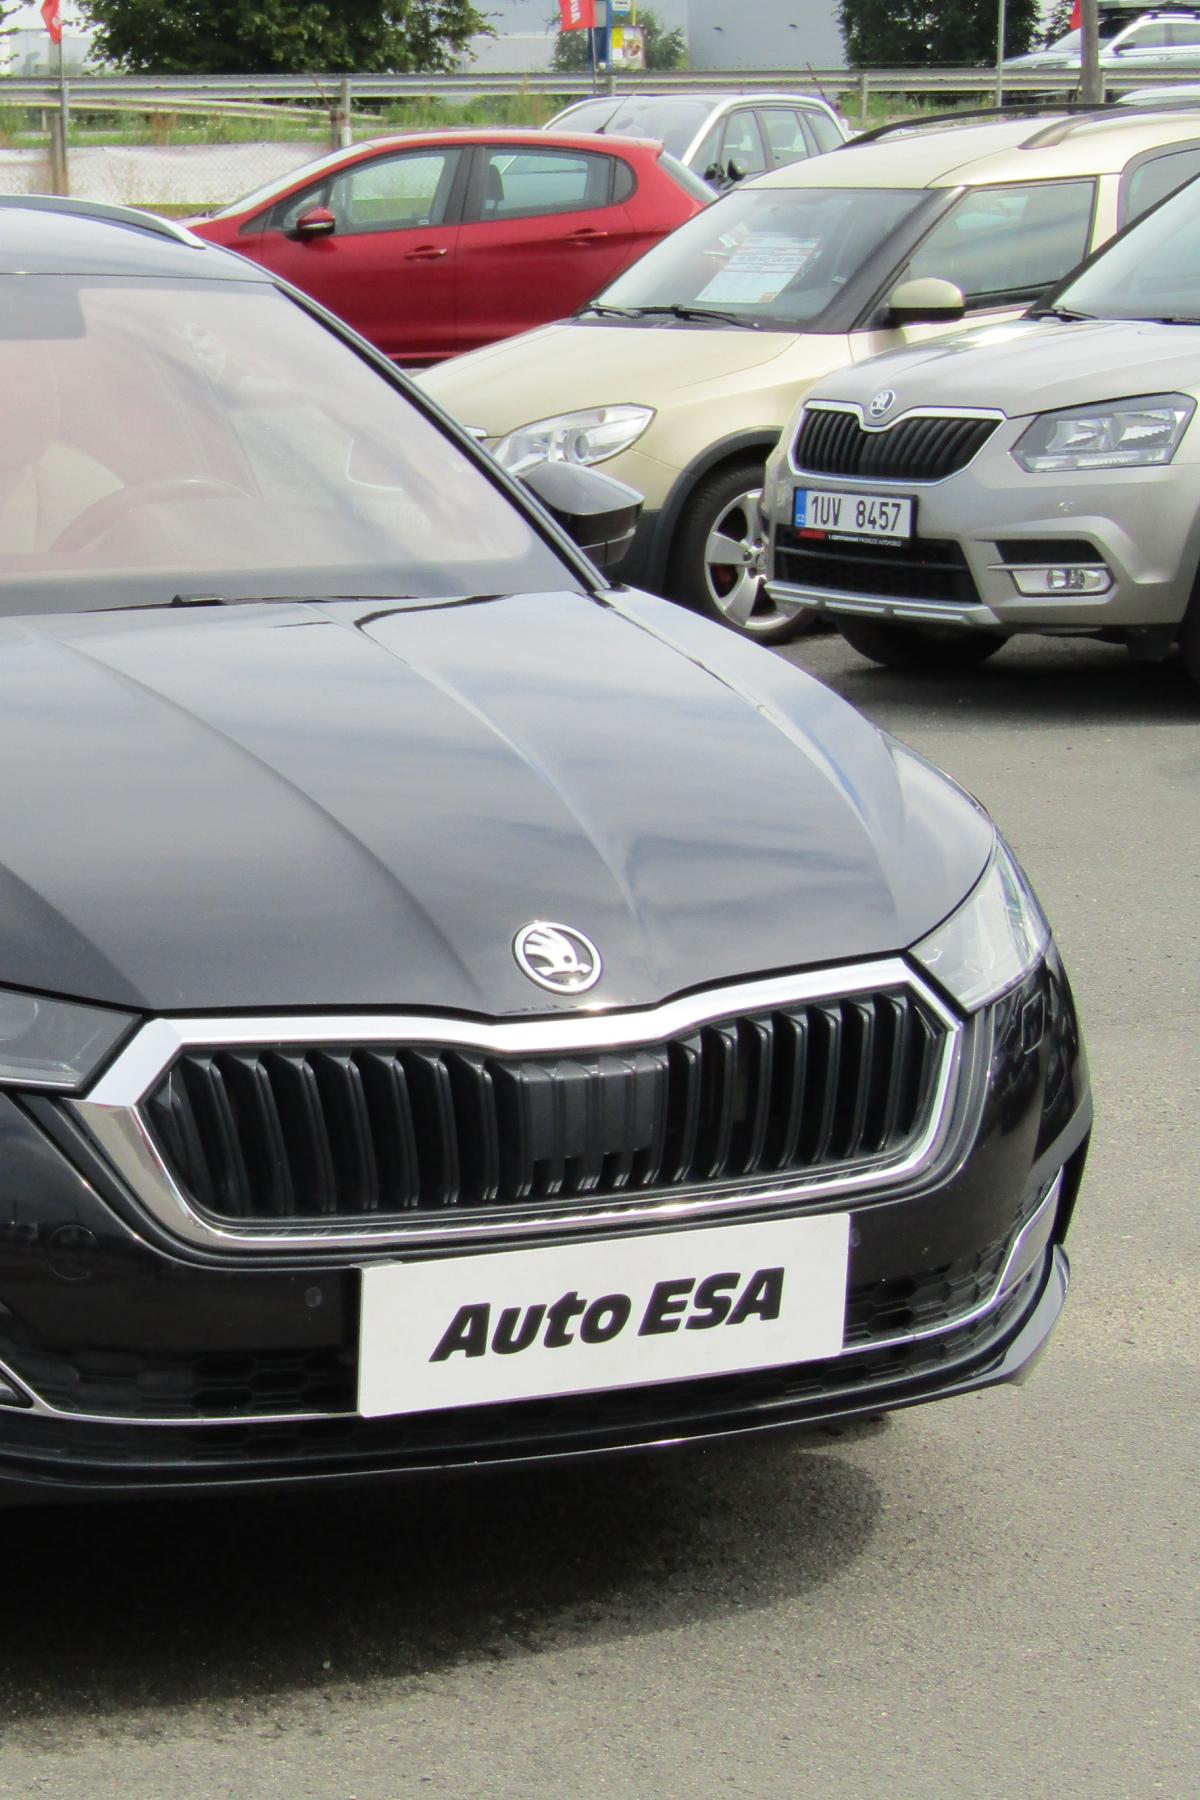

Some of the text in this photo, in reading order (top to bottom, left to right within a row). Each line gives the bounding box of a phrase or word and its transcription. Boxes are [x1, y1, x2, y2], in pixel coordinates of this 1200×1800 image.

[811, 495, 902, 531] 1UV 8457
[429, 1268, 785, 1362] Auto ESA
